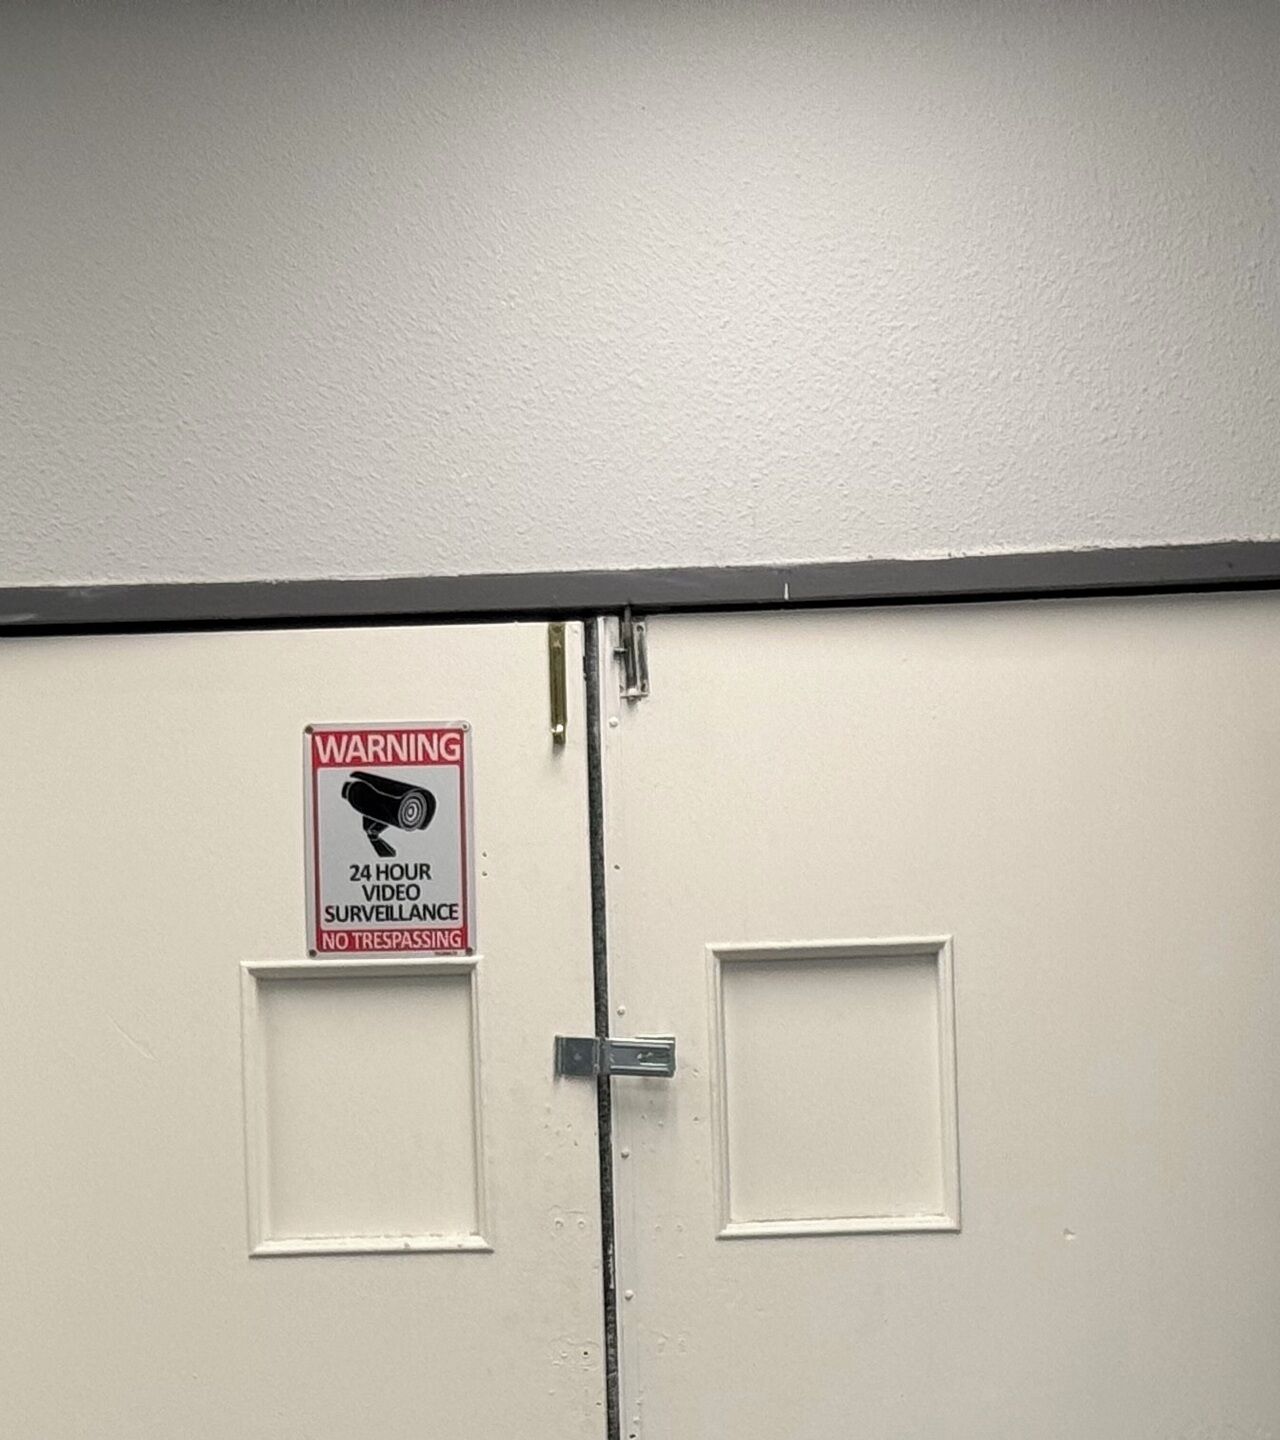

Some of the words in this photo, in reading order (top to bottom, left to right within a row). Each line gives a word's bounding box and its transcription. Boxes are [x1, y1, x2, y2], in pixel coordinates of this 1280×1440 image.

[314, 732, 461, 764] WARNING
[349, 864, 372, 881] 24
[376, 863, 432, 881] HOUR
[362, 884, 421, 902] VIDEO
[324, 903, 459, 923] SURVEILLANCE
[323, 932, 349, 950] NO
[351, 931, 463, 950] TRESPASSING
